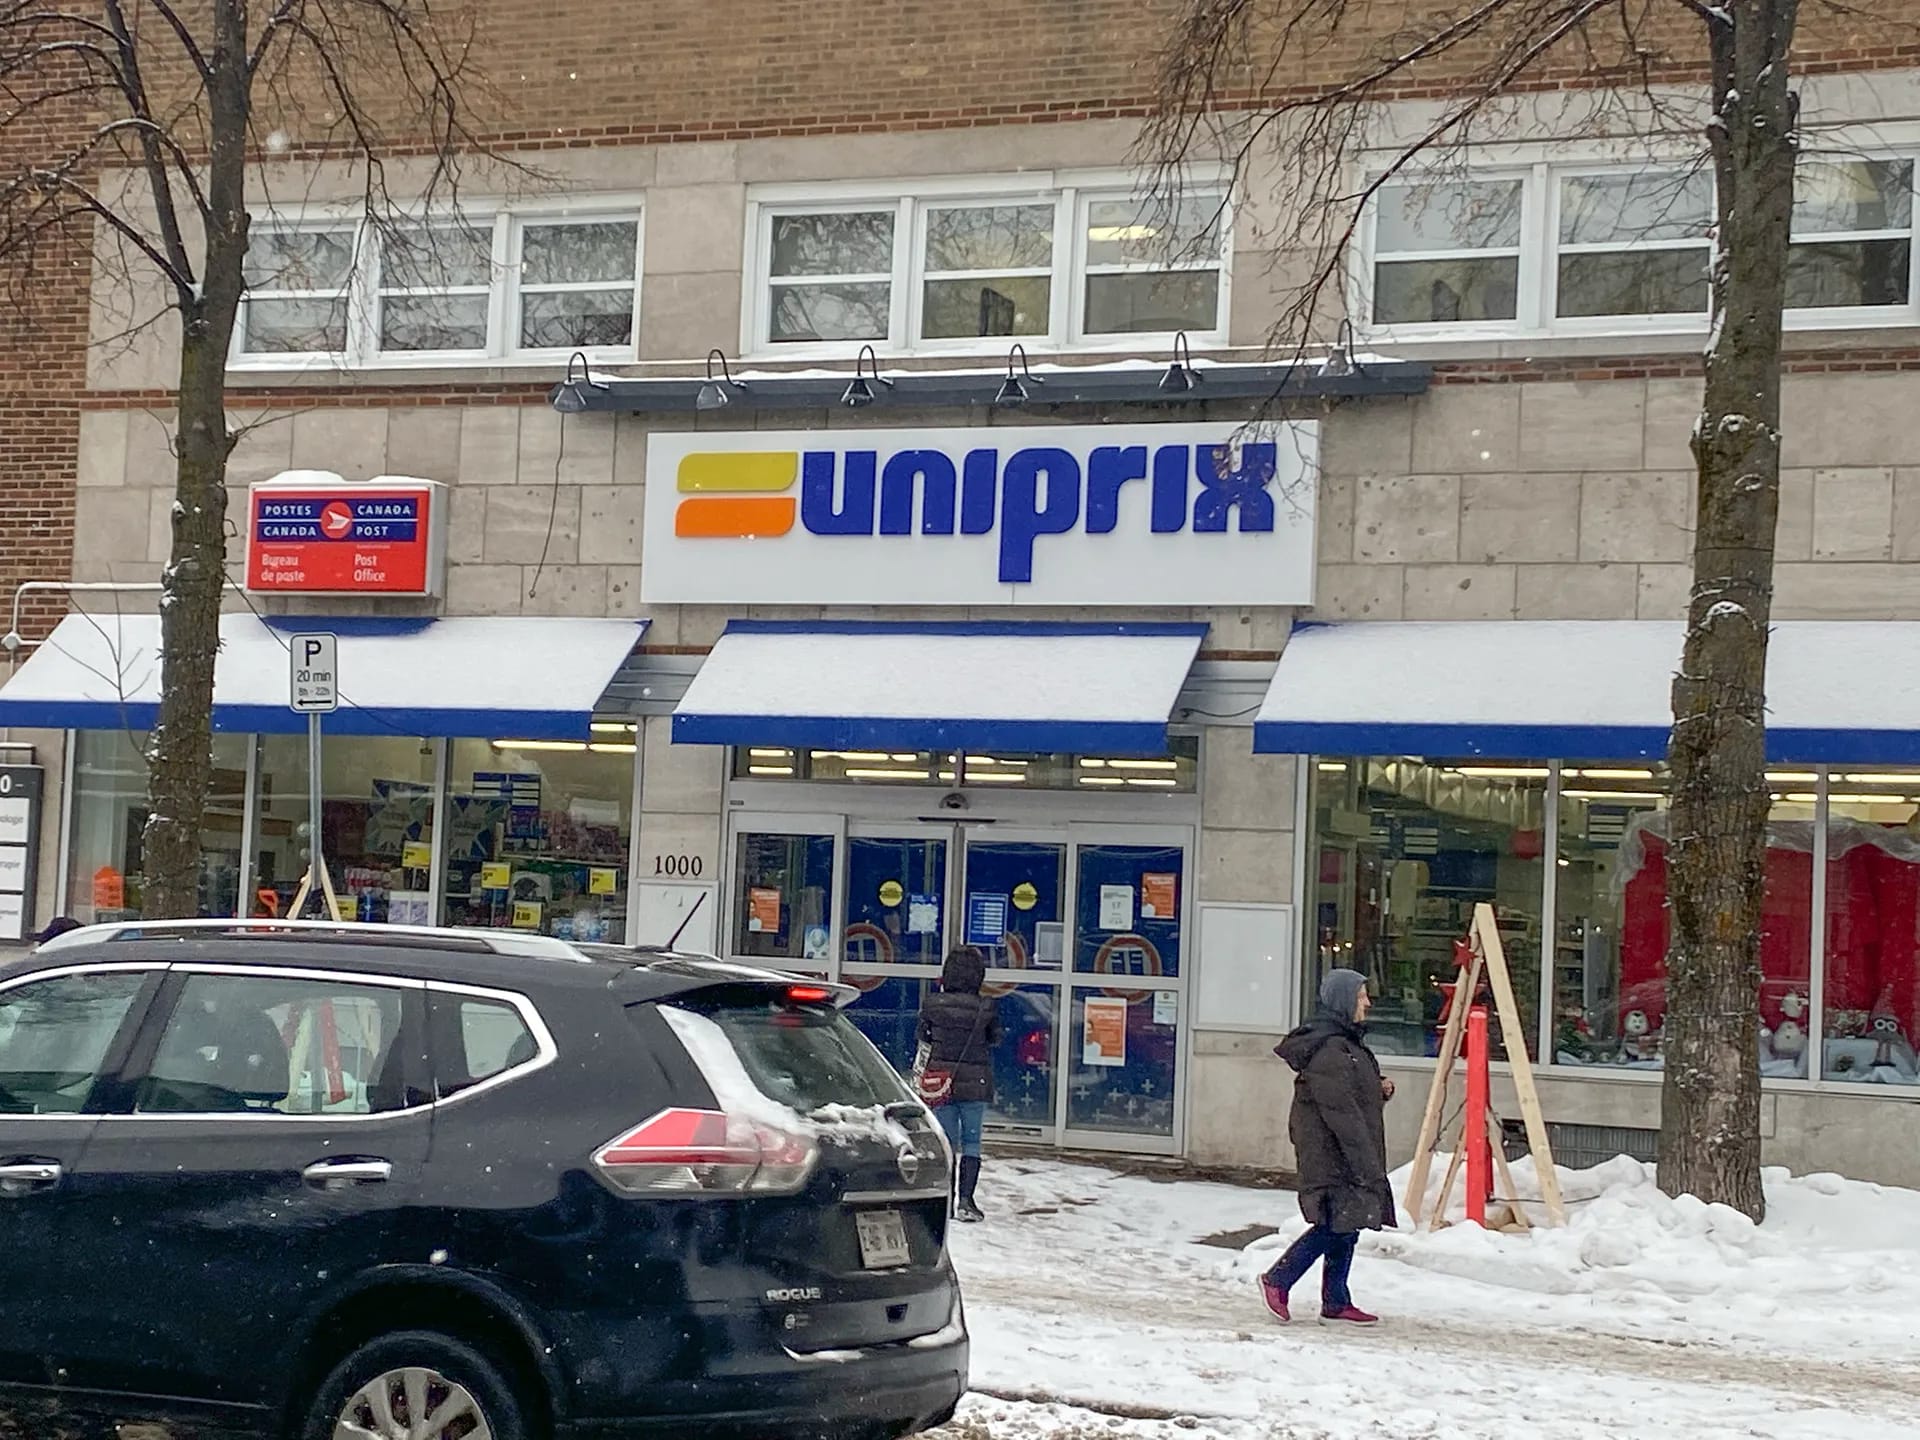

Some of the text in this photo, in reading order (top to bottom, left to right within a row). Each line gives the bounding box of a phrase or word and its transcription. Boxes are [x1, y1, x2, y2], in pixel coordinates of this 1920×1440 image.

[264, 504, 312, 516] POSTES
[356, 504, 412, 516] CANADA
[801, 443, 1277, 583] uniprix
[263, 525, 317, 537] CANADA
[356, 525, 389, 537] POST
[261, 553, 299, 567] Bureau
[354, 553, 378, 567] Post
[260, 568, 305, 584] de poste
[353, 568, 386, 583] Office
[305, 640, 322, 667] P
[296, 668, 332, 682] 20 min
[655, 855, 703, 876] 1000
[766, 1287, 821, 1301] ROGUE
